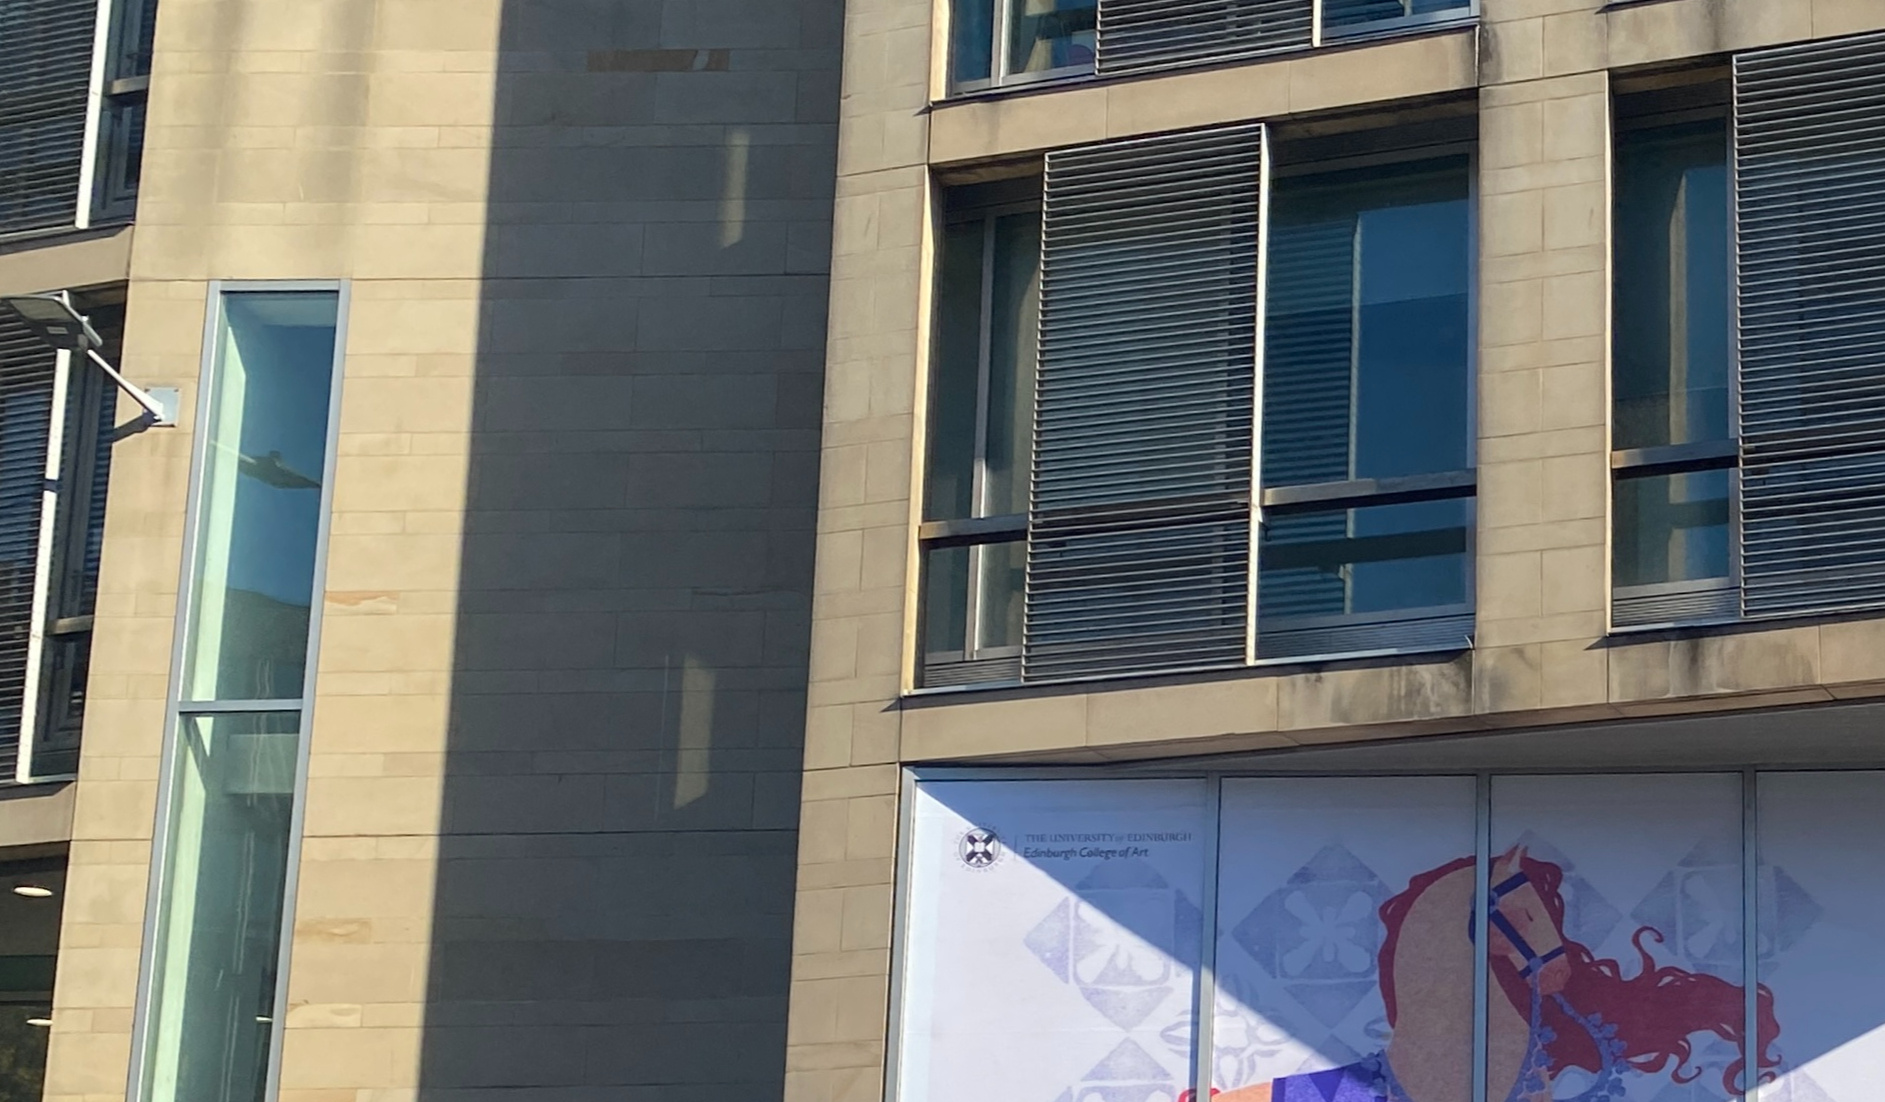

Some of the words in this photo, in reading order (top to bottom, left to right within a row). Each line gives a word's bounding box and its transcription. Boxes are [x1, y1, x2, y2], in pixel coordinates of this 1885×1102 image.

[1026, 834, 1047, 842] THE
[1050, 833, 1114, 843] UNIVERSITY
[1127, 832, 1192, 842] EDINBURGH
[1023, 846, 1077, 860] Edinburgh
[1079, 846, 1117, 860] College
[1119, 847, 1131, 858] of
[1132, 847, 1149, 858] Art
